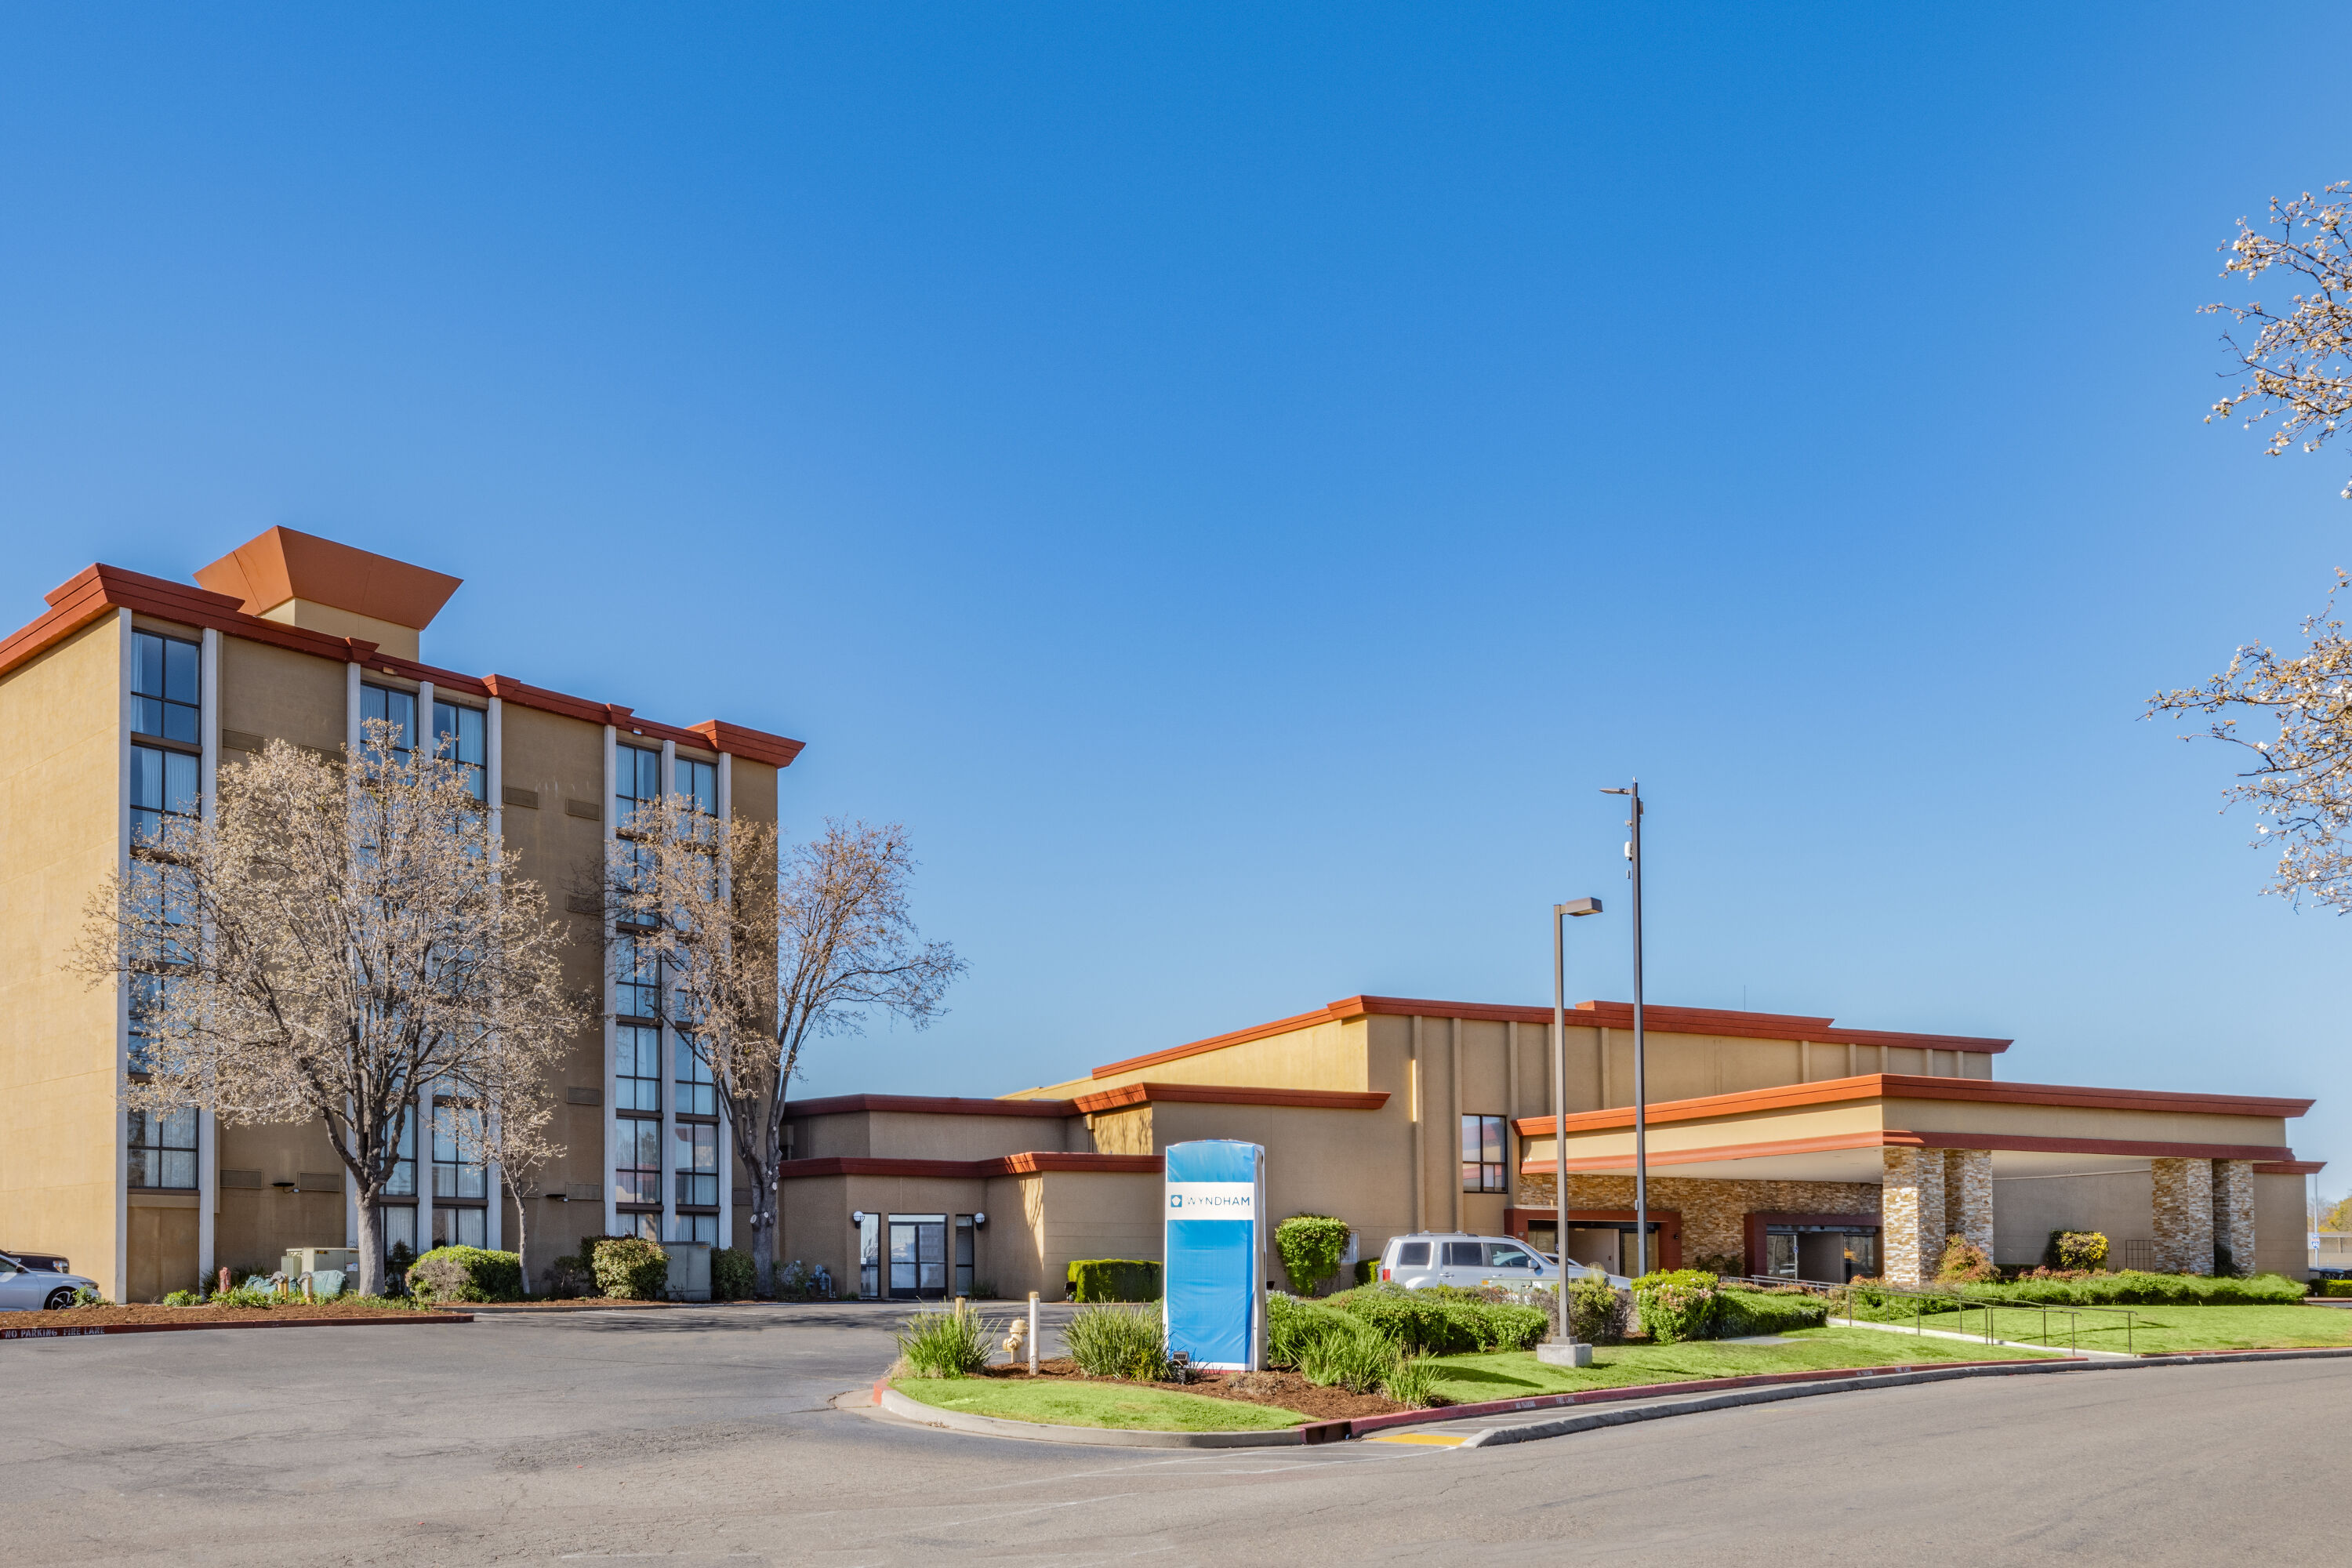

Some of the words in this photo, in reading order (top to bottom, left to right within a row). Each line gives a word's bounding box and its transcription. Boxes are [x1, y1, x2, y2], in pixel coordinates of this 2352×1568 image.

[1187, 1196, 1250, 1206] WYNDHAM
[5, 1330, 17, 1338] NO
[20, 1328, 58, 1338] PARKING
[64, 1327, 81, 1336] FIRE
[84, 1326, 105, 1335] LANE
